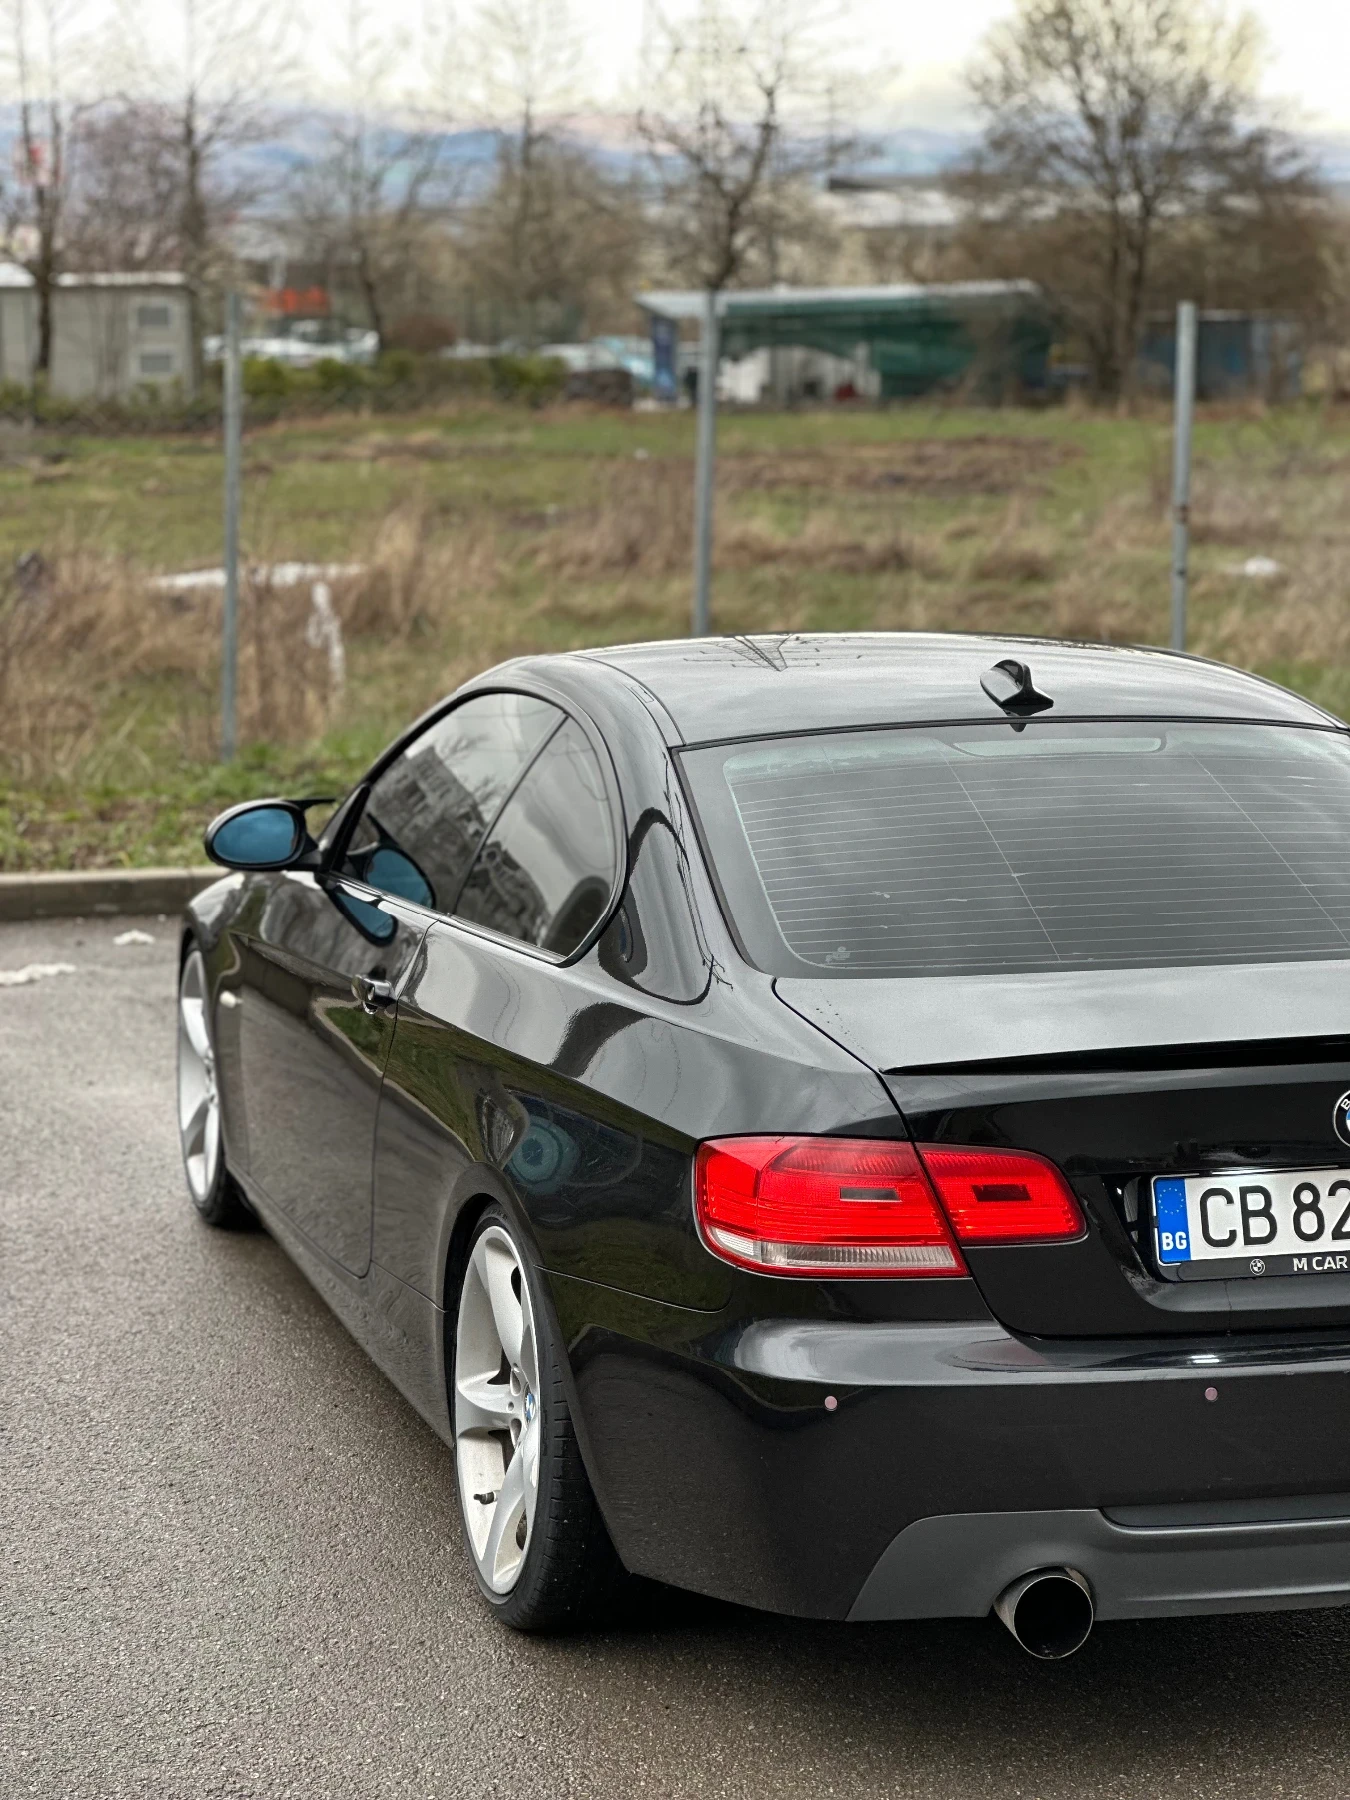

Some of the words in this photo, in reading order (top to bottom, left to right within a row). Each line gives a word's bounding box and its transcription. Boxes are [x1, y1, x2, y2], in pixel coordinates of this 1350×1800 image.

[1200, 1185, 1278, 1247] CB
[1293, 1180, 1350, 1242] 82
[1161, 1232, 1187, 1250] BG
[1293, 1257, 1308, 1271] M
[1312, 1255, 1349, 1271] CAR
